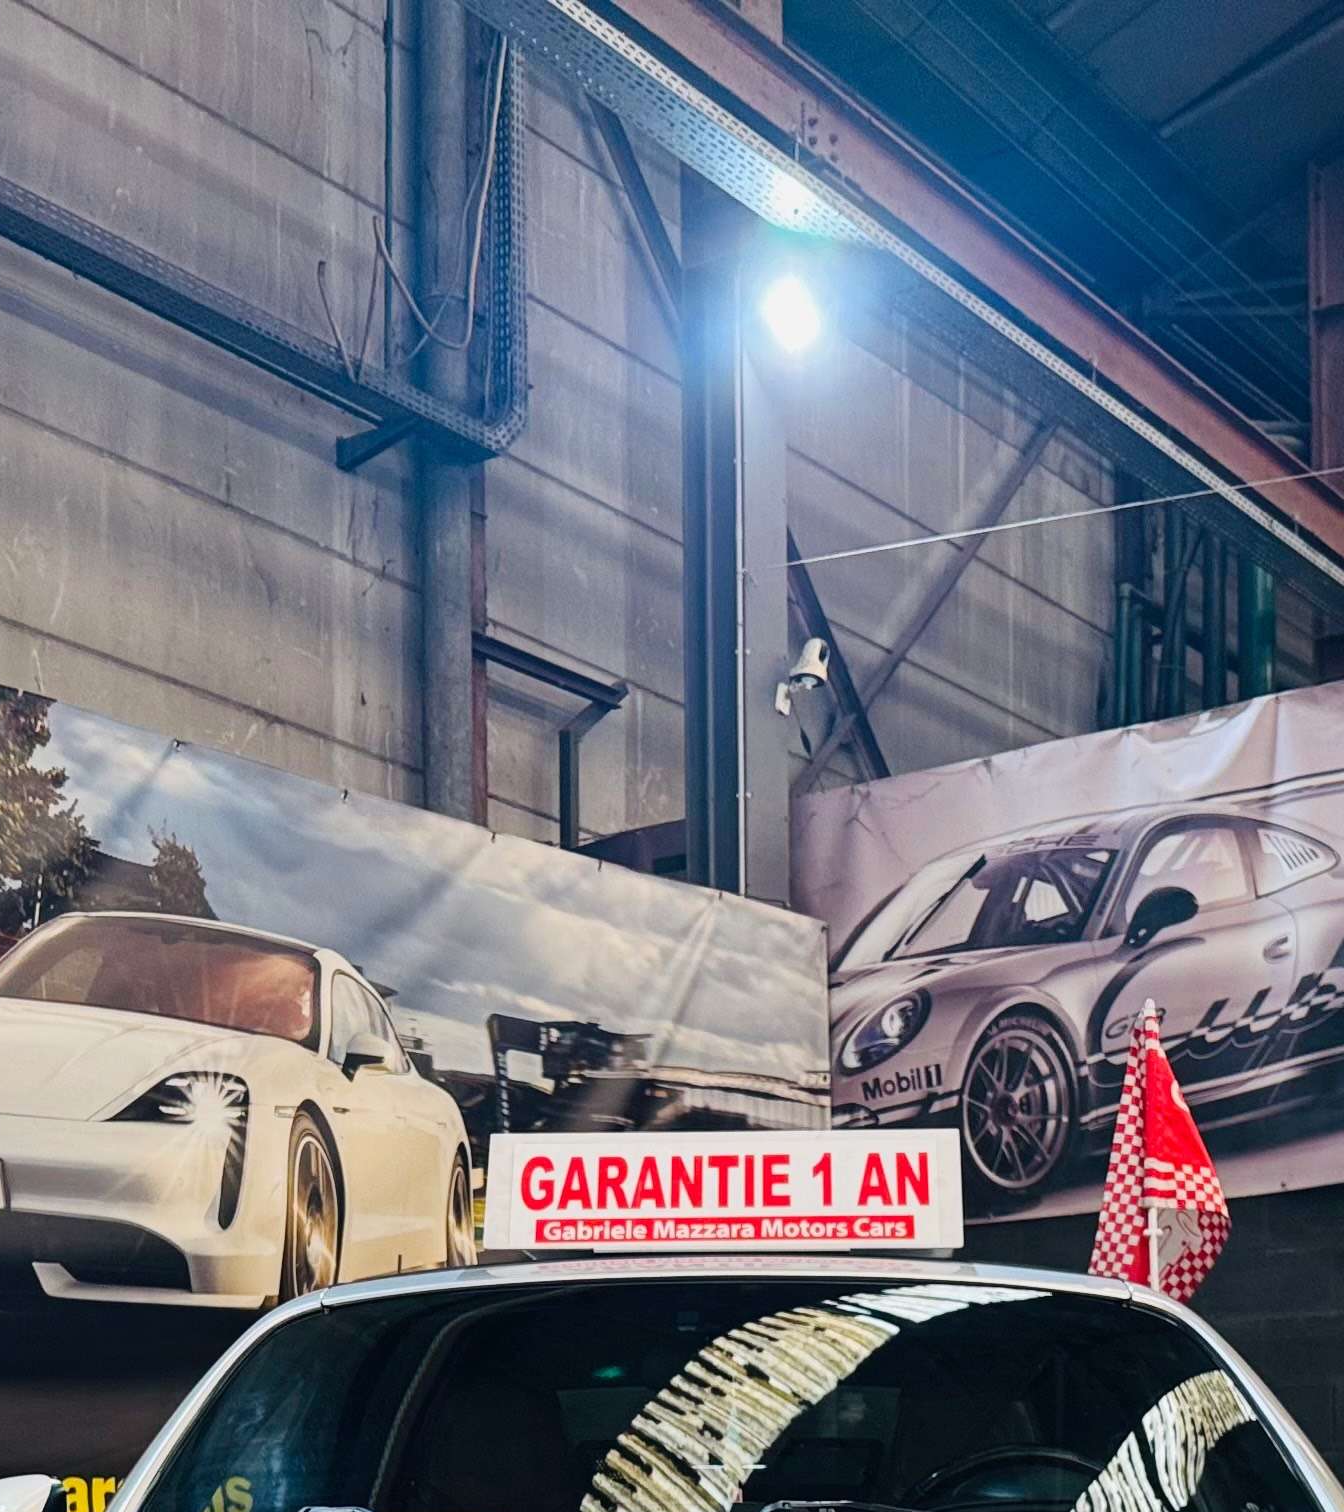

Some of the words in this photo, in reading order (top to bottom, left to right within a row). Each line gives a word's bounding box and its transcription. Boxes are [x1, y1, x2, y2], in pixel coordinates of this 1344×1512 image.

[519, 1153, 792, 1212] GARANTIE
[811, 1151, 833, 1208] 1
[856, 1151, 931, 1207] AN
[543, 1218, 647, 1241] Gabriele
[652, 1219, 756, 1241] Mazzara
[760, 1218, 849, 1238] Motors
[853, 1217, 907, 1238] Cars
